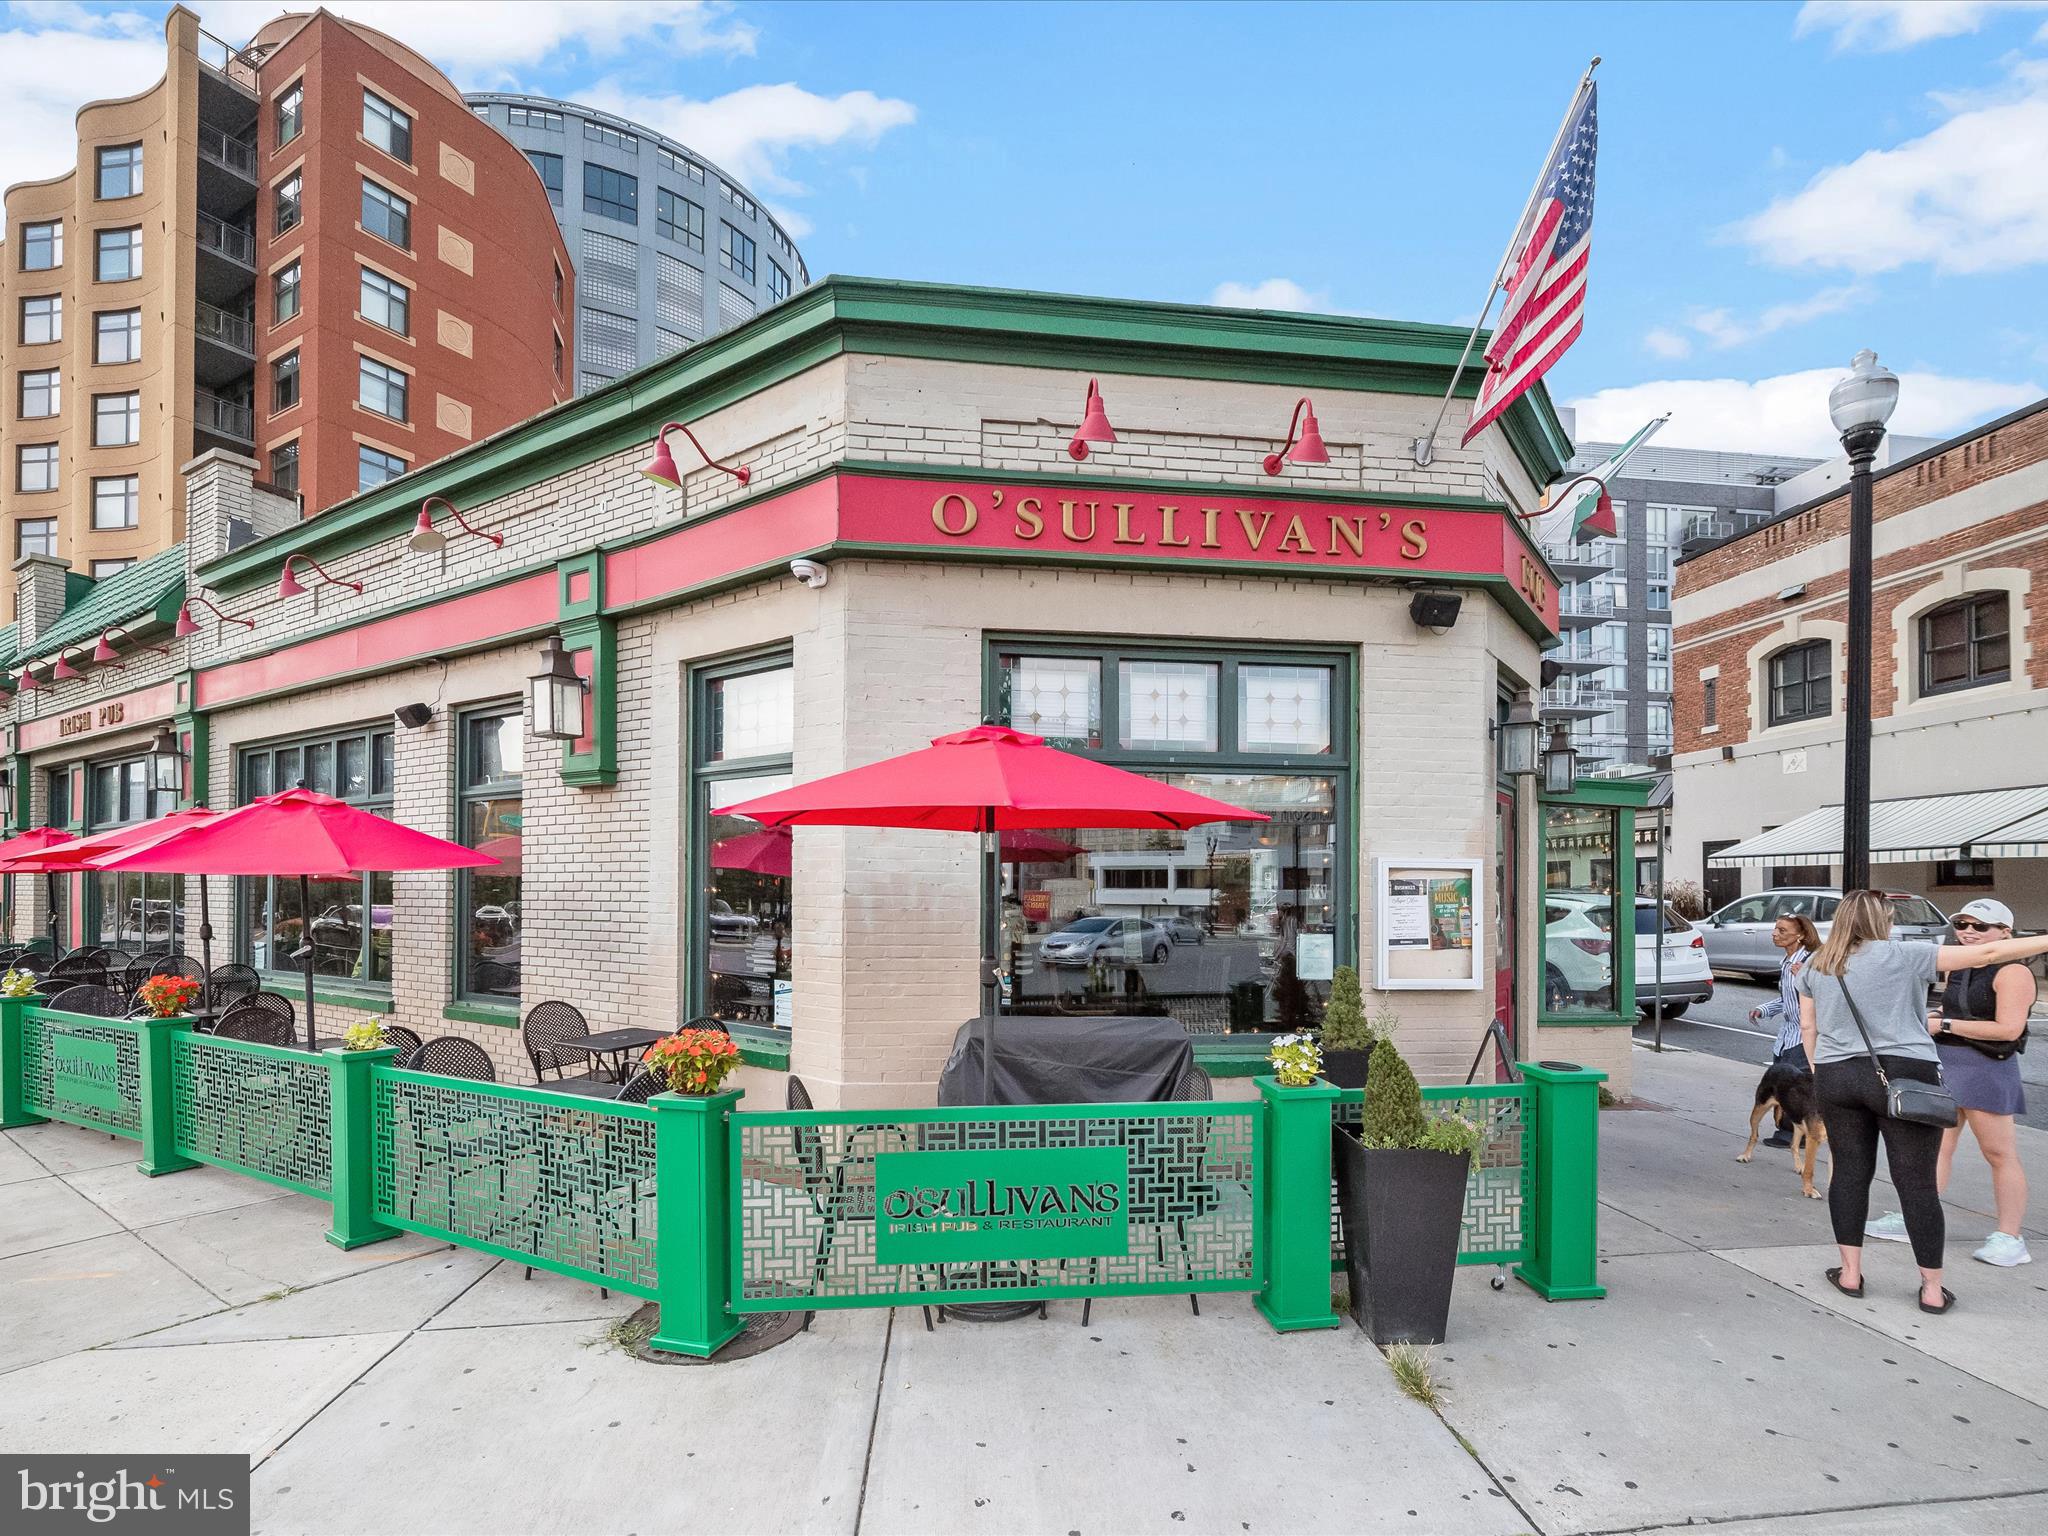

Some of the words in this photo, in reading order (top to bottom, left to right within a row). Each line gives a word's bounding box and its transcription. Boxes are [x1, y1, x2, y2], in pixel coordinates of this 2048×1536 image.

[931, 489, 1429, 560] O'SULLIVAN'S
[1520, 554, 1546, 612] PUB
[59, 711, 92, 737] IRISH
[98, 702, 125, 727] PUB
[1434, 892, 1459, 903] MUSIC
[889, 1222, 936, 1234] IRISH
[941, 1221, 979, 1232] PUB
[982, 1220, 993, 1231] &
[999, 1216, 1113, 1230] RESTAURANT
